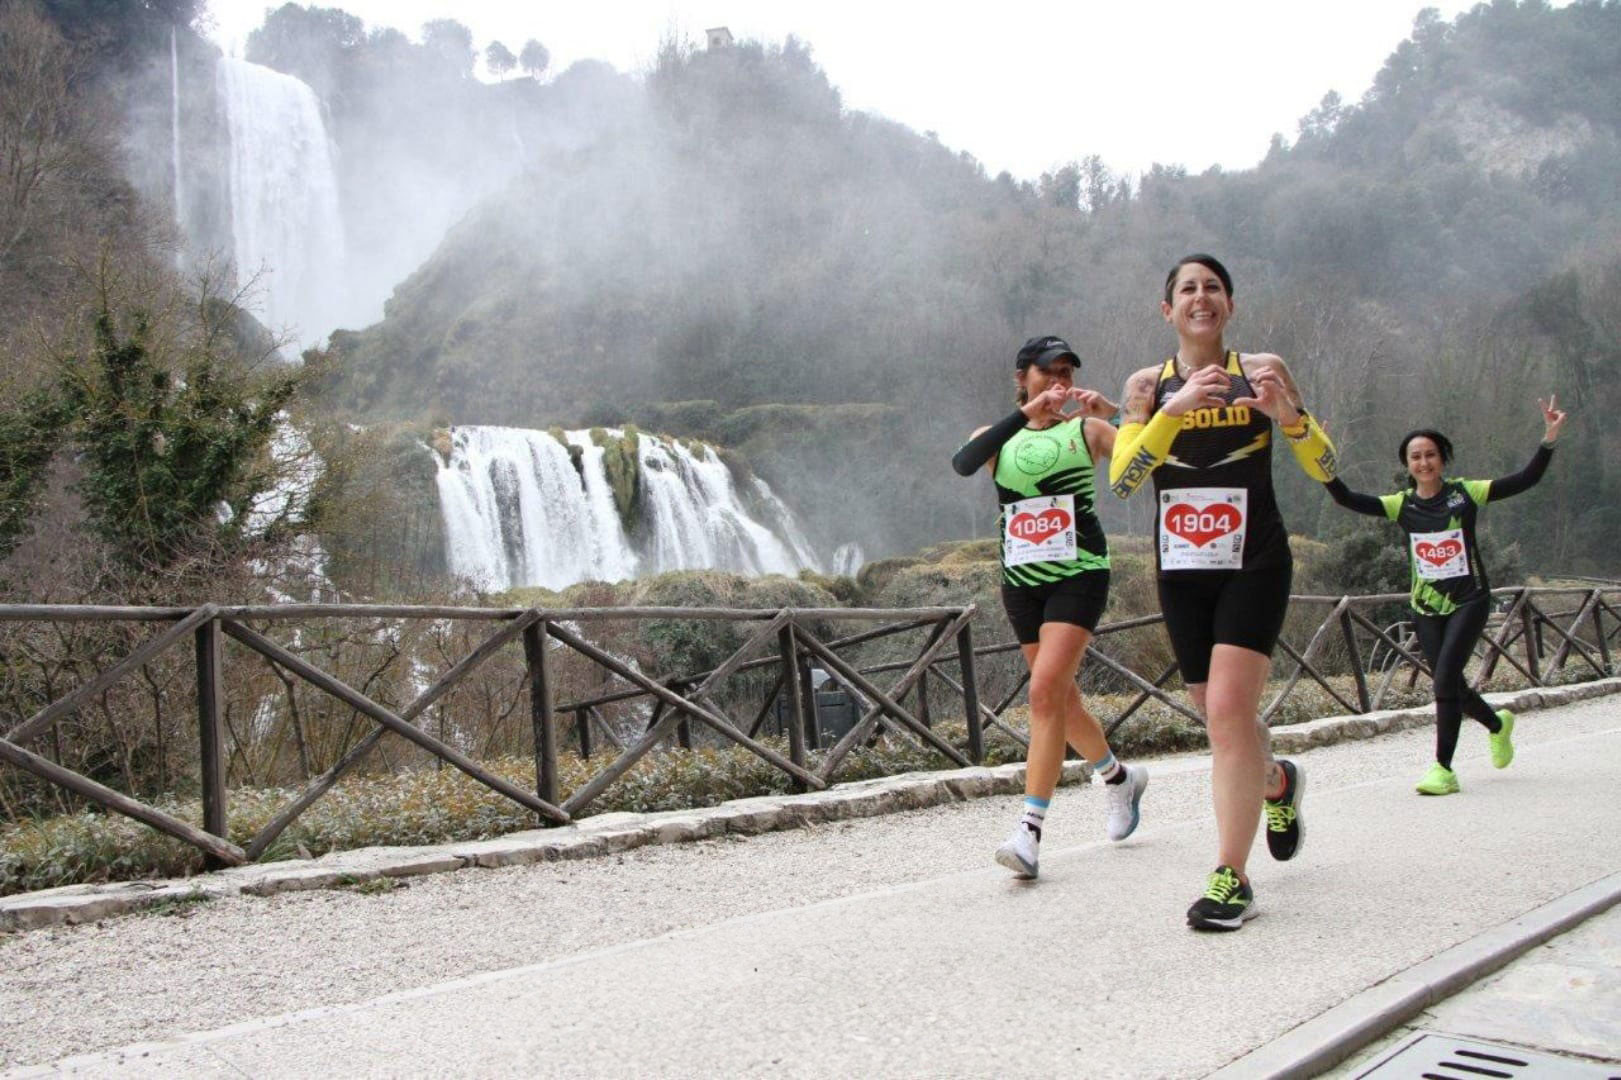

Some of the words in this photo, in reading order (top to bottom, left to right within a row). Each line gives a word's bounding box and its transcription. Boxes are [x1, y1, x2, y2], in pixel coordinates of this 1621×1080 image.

[1183, 406, 1250, 430] SOLID
[1014, 516, 1062, 537] 1084
[1172, 513, 1232, 534] 1904
[1420, 545, 1460, 559] 1483
